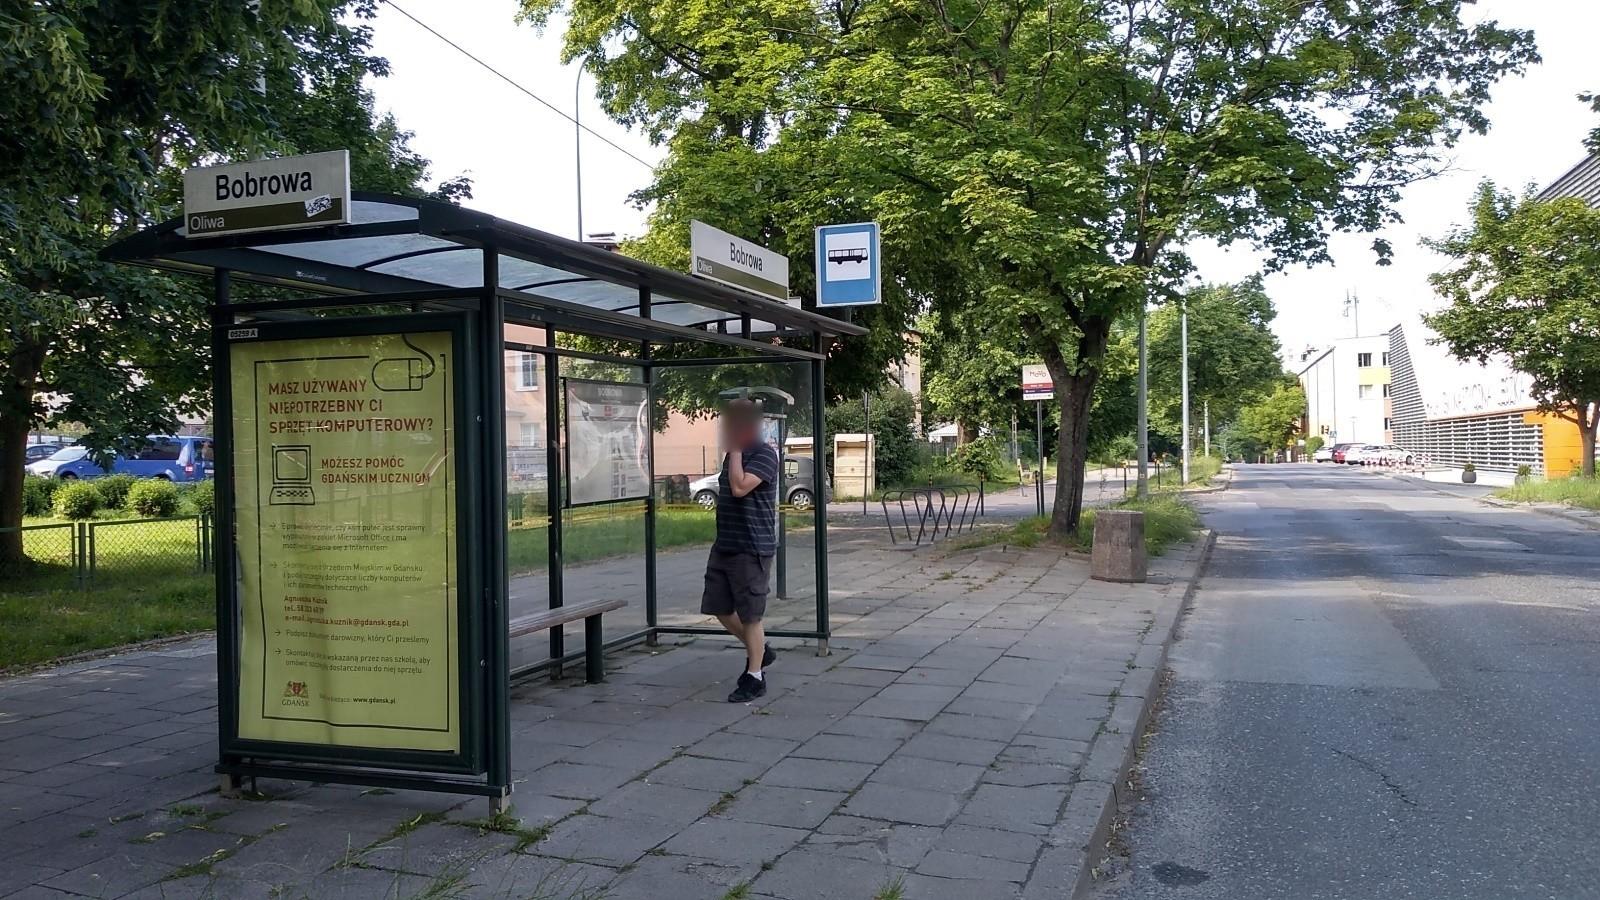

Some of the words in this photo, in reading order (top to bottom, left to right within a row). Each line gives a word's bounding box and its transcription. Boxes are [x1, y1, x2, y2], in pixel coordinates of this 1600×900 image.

[215, 170, 312, 201] Bobrowa
[190, 215, 225, 231] Oliwa
[730, 242, 763, 272] Bobrowa
[268, 382, 300, 395] MASZ
[302, 378, 367, 394] UŻYWANY
[268, 399, 364, 414] NIEPOTRZEBNY
[369, 399, 383, 412] CI
[269, 420, 312, 437] SPRZĘT
[316, 417, 433, 433] KOMPUTEROWY?
[321, 456, 363, 468] MOŻESZ
[365, 456, 405, 468] POMÓC
[321, 471, 378, 484] GDAŃSKIM
[380, 472, 431, 484] UCZNIOM
[337, 533, 369, 542] Microsoft
[360, 655, 380, 664] przez
[419, 656, 431, 666] aby
[329, 664, 371, 673] dostarczenia
[373, 664, 382, 672] do
[384, 664, 396, 674] niej
